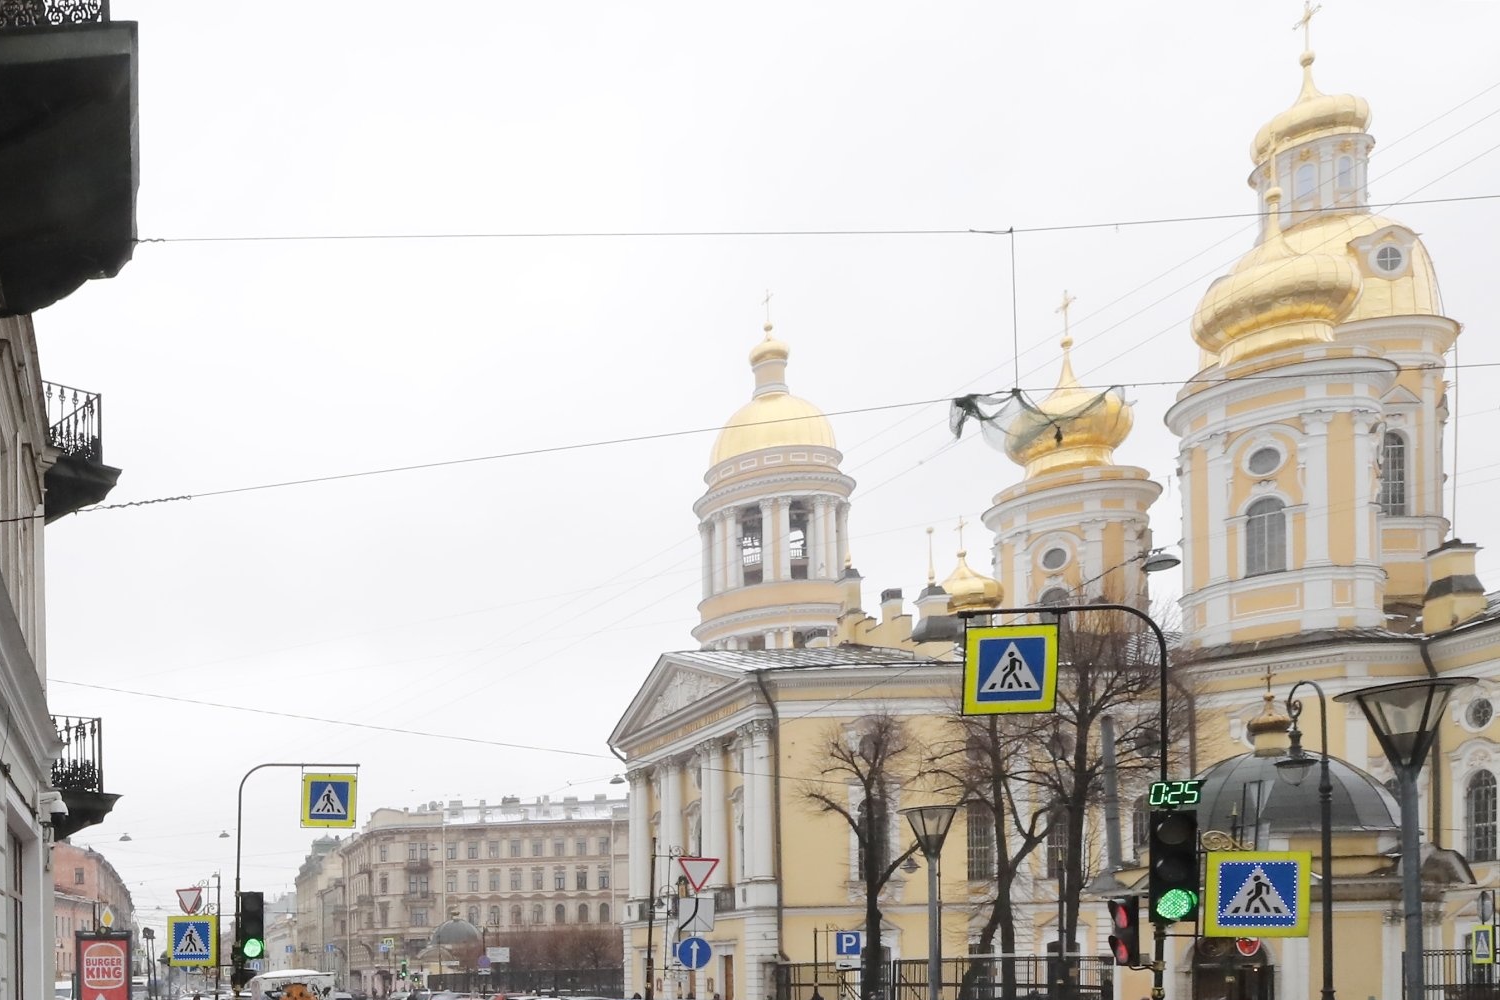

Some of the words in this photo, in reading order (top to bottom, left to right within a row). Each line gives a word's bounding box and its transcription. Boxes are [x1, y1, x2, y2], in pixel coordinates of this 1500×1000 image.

[1149, 780, 1199, 806] 0:25
[85, 957, 122, 967] BURGER
[85, 967, 122, 979] KING
